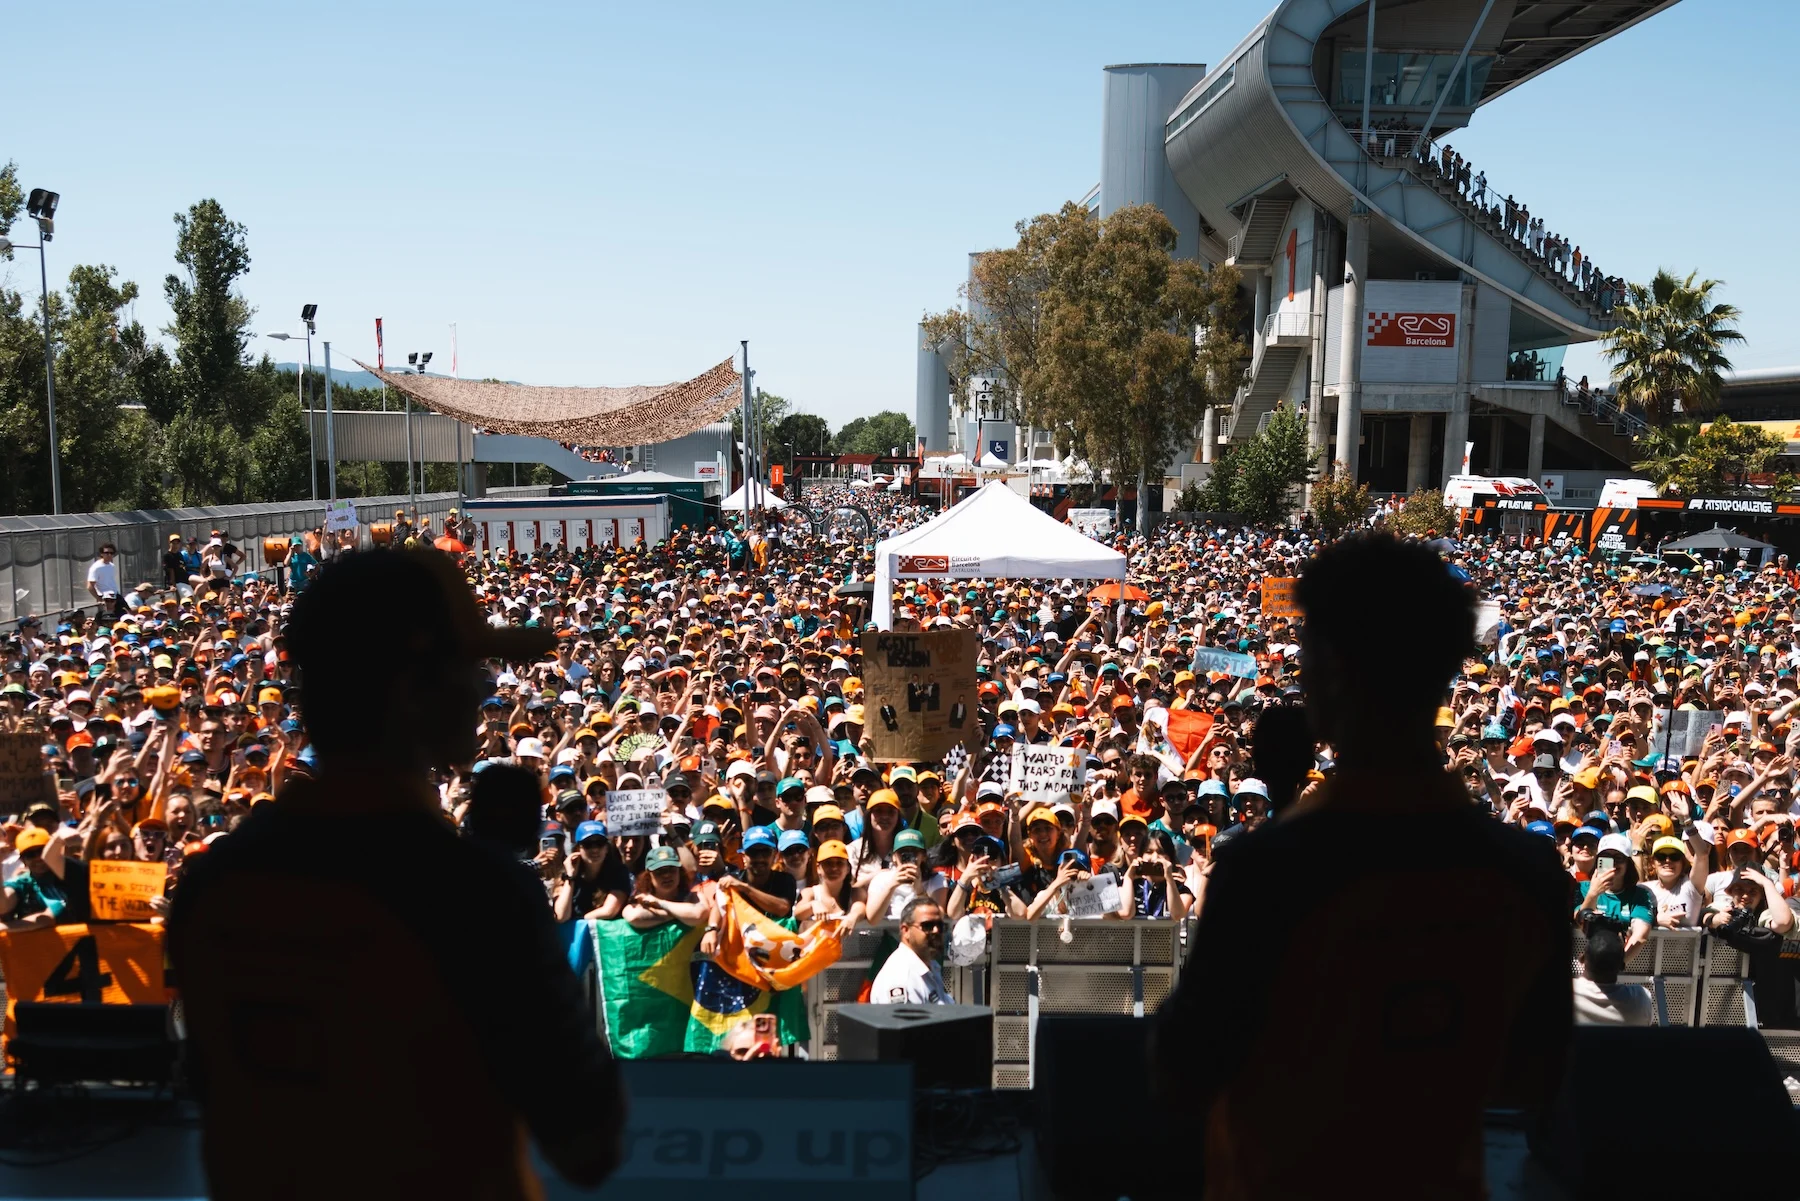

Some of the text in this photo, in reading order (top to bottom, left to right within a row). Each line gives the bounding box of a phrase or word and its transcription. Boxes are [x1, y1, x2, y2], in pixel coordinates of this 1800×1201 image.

[1286, 228, 1297, 302] 1
[1405, 337, 1447, 346] Barcelona
[1705, 499, 1733, 512] PITSTOP
[1733, 500, 1773, 513] CHALLENGE
[1602, 533, 1623, 542] PITSTOP
[1598, 541, 1627, 550] CHALLENGE
[876, 636, 920, 653] AGENT
[1023, 752, 1065, 766] WAITED
[1022, 765, 1079, 780] YEARS FOR
[1017, 779, 1085, 793] THIS MOMENT
[609, 793, 632, 803] LANDO
[637, 792, 646, 802] IF
[625, 803, 637, 811] ME
[638, 802, 660, 810] YOUR
[610, 814, 626, 822] CAP
[97, 896, 119, 911] THE
[43, 934, 113, 1003] 4
[626, 1126, 907, 1179] rap up
